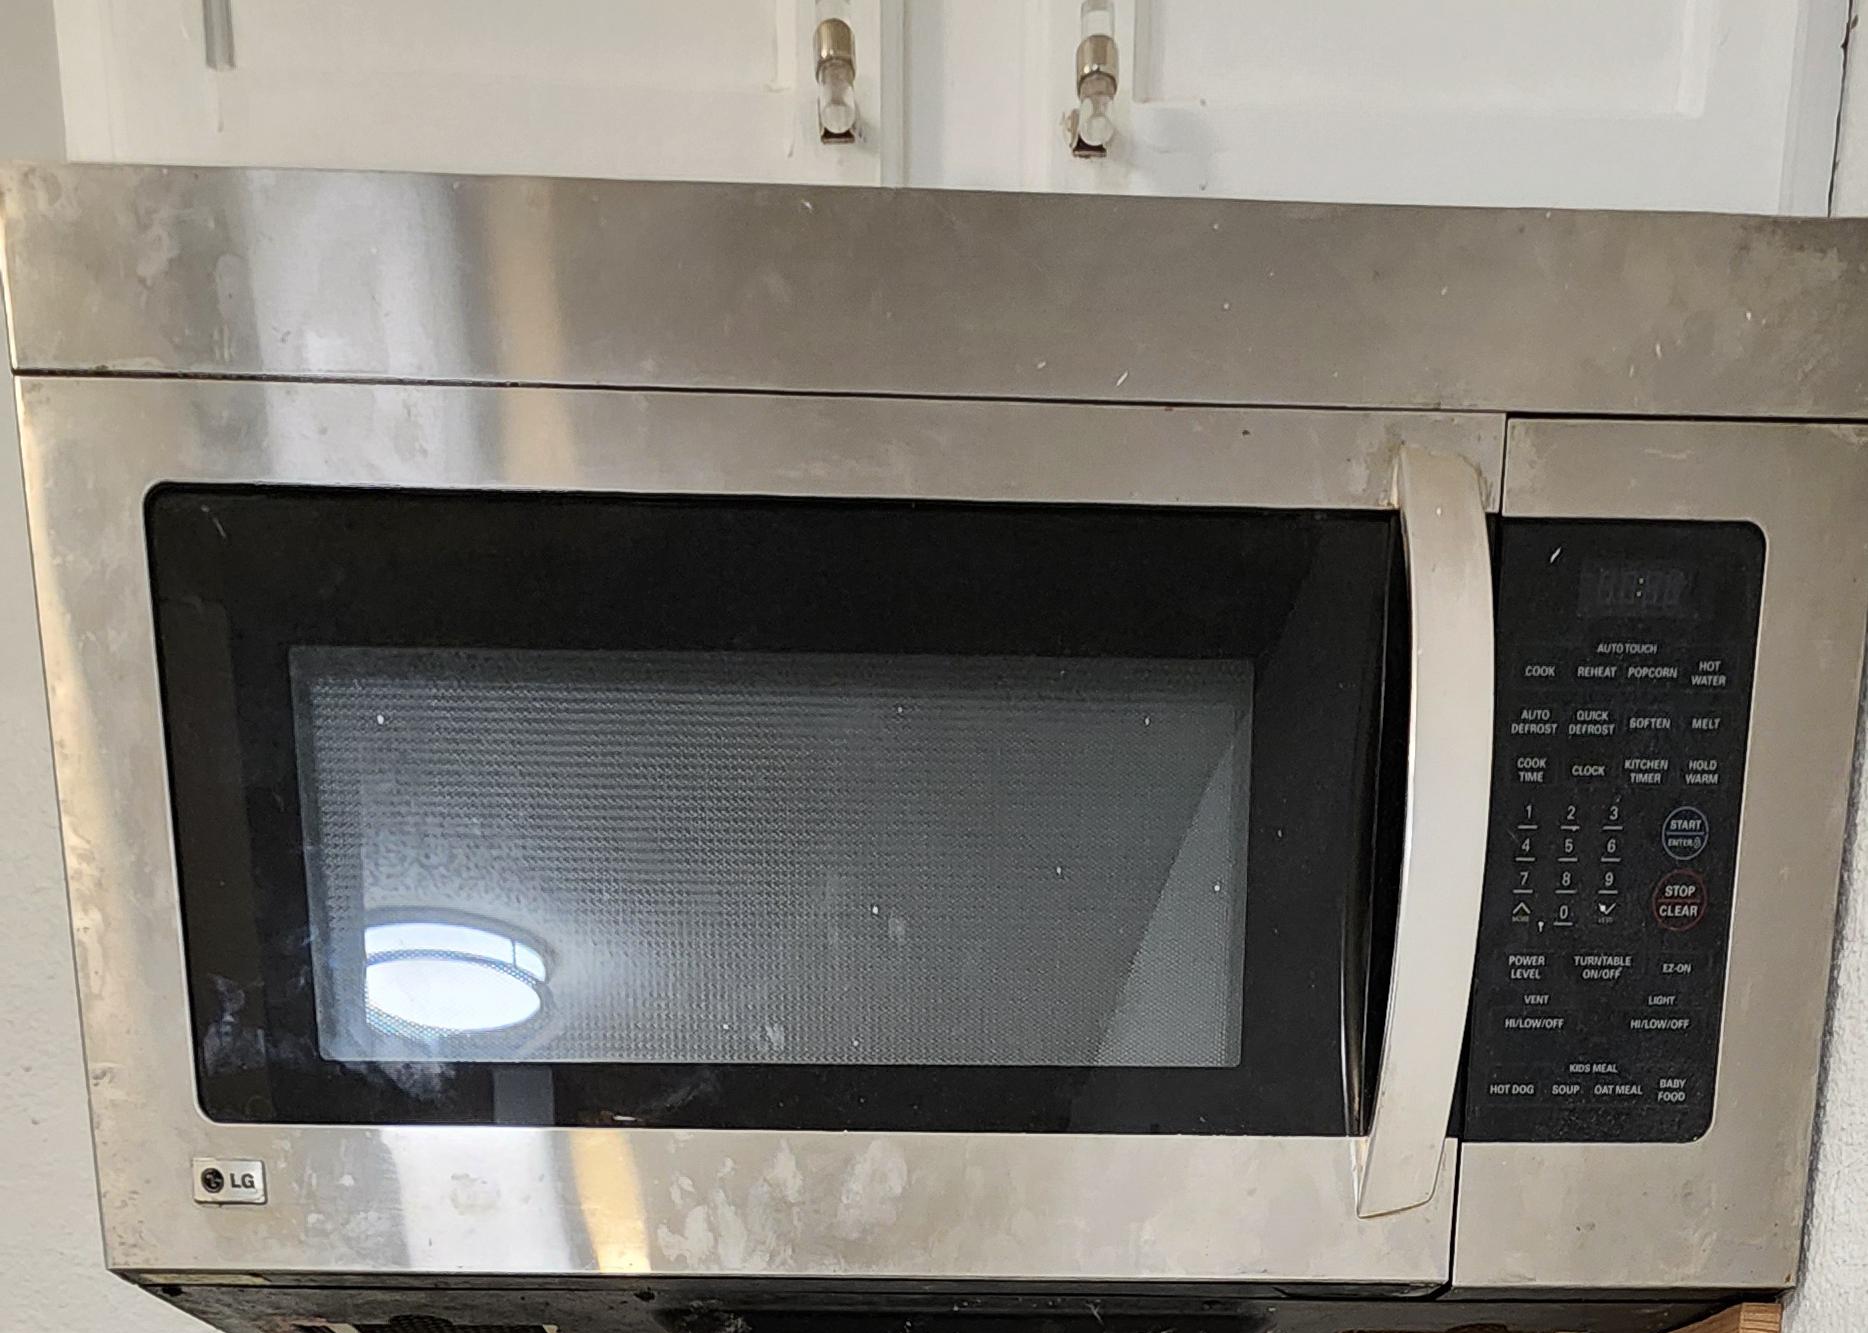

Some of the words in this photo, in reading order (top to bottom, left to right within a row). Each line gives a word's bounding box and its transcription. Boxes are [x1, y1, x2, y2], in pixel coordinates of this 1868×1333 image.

[1596, 643, 1624, 654] AUTO
[1624, 643, 1658, 655] TOUCH
[1524, 665, 1556, 677] COOK
[1577, 666, 1617, 678] REHEAT
[1698, 660, 1721, 672] HOT
[1627, 666, 1678, 679] POPCORN
[1690, 674, 1727, 687] WATER
[1520, 709, 1550, 721] AUTO
[1576, 709, 1609, 721] QUICK
[1510, 723, 1557, 735] DEFROST
[1568, 723, 1615, 735] DEFROST
[1629, 717, 1671, 729] SOFTEN
[1691, 718, 1721, 730] MELT
[1516, 757, 1546, 769] COOK
[1624, 758, 1668, 770] KITCHEN
[1688, 759, 1717, 771] HOLD
[1571, 764, 1605, 777] CLOCK
[1518, 771, 1544, 783] TIME
[1630, 772, 1661, 784] TIMER
[1685, 773, 1718, 785] WARM
[1526, 805, 1533, 819] 1
[1567, 805, 1576, 820] 2
[1609, 805, 1619, 820] 3
[1670, 819, 1702, 830] START
[1521, 838, 1531, 852] 4
[1564, 838, 1574, 852] 5
[1607, 838, 1617, 852] 6
[1667, 838, 1693, 847] ENTER
[1520, 872, 1529, 885] 7
[1562, 872, 1571, 886] 8
[1604, 872, 1614, 886] 9
[1664, 884, 1696, 897] STOP
[1559, 904, 1569, 919] 0
[1659, 905, 1698, 917] CLEAR
[1508, 955, 1545, 967] POWER
[1574, 955, 1631, 967] TURNTABLE
[1511, 968, 1541, 980] LEVEL
[1582, 968, 1621, 980] ON/OFF
[1662, 963, 1692, 975] EZ-ON
[1524, 994, 1549, 1005] VENT
[1648, 995, 1676, 1006] LIGHT
[1505, 1018, 1564, 1029] HI/LOW/OFF
[1630, 1018, 1690, 1030] HI/LOW/OFF
[1569, 1063, 1591, 1073] KIDS
[1592, 1063, 1619, 1074] MEAL
[1490, 1084, 1510, 1094] HOT
[1511, 1084, 1535, 1095] DOG
[1552, 1084, 1580, 1095] SOUP
[1594, 1084, 1616, 1095] OAT
[1617, 1084, 1643, 1095] MEAL
[1659, 1078, 1687, 1089] BABY
[1657, 1091, 1686, 1102] FOOD
[229, 1172, 256, 1189] LG
